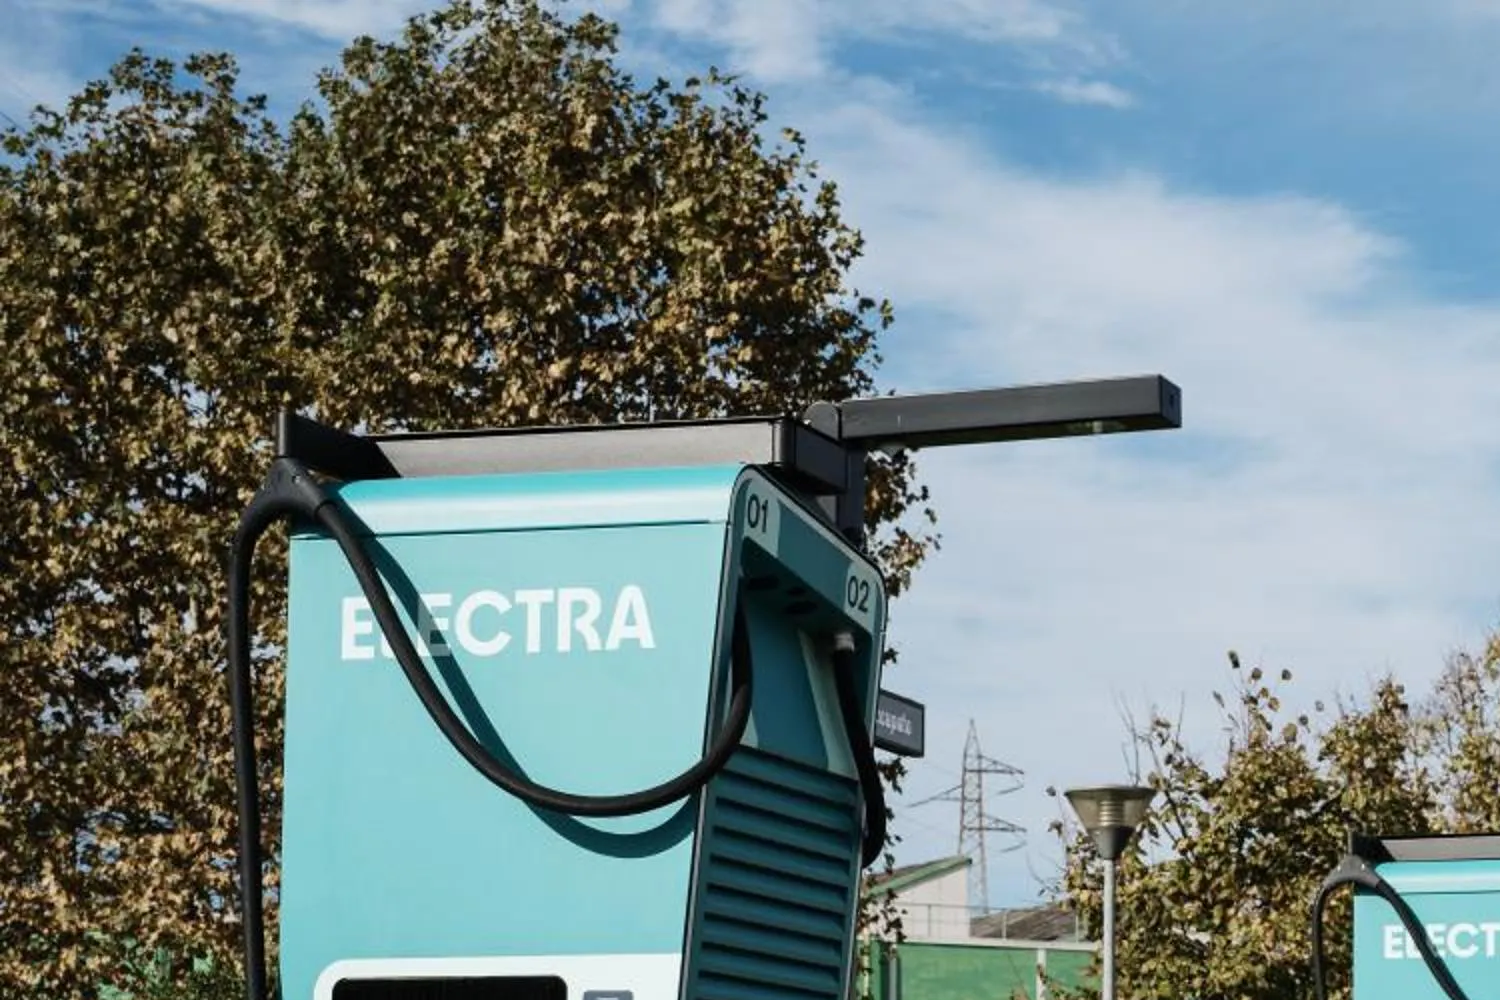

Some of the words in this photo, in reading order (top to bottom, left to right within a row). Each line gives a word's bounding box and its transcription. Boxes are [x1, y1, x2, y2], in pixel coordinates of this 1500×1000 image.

[747, 493, 768, 533] 01
[847, 575, 869, 612] 02
[341, 585, 657, 660] EECTRA
